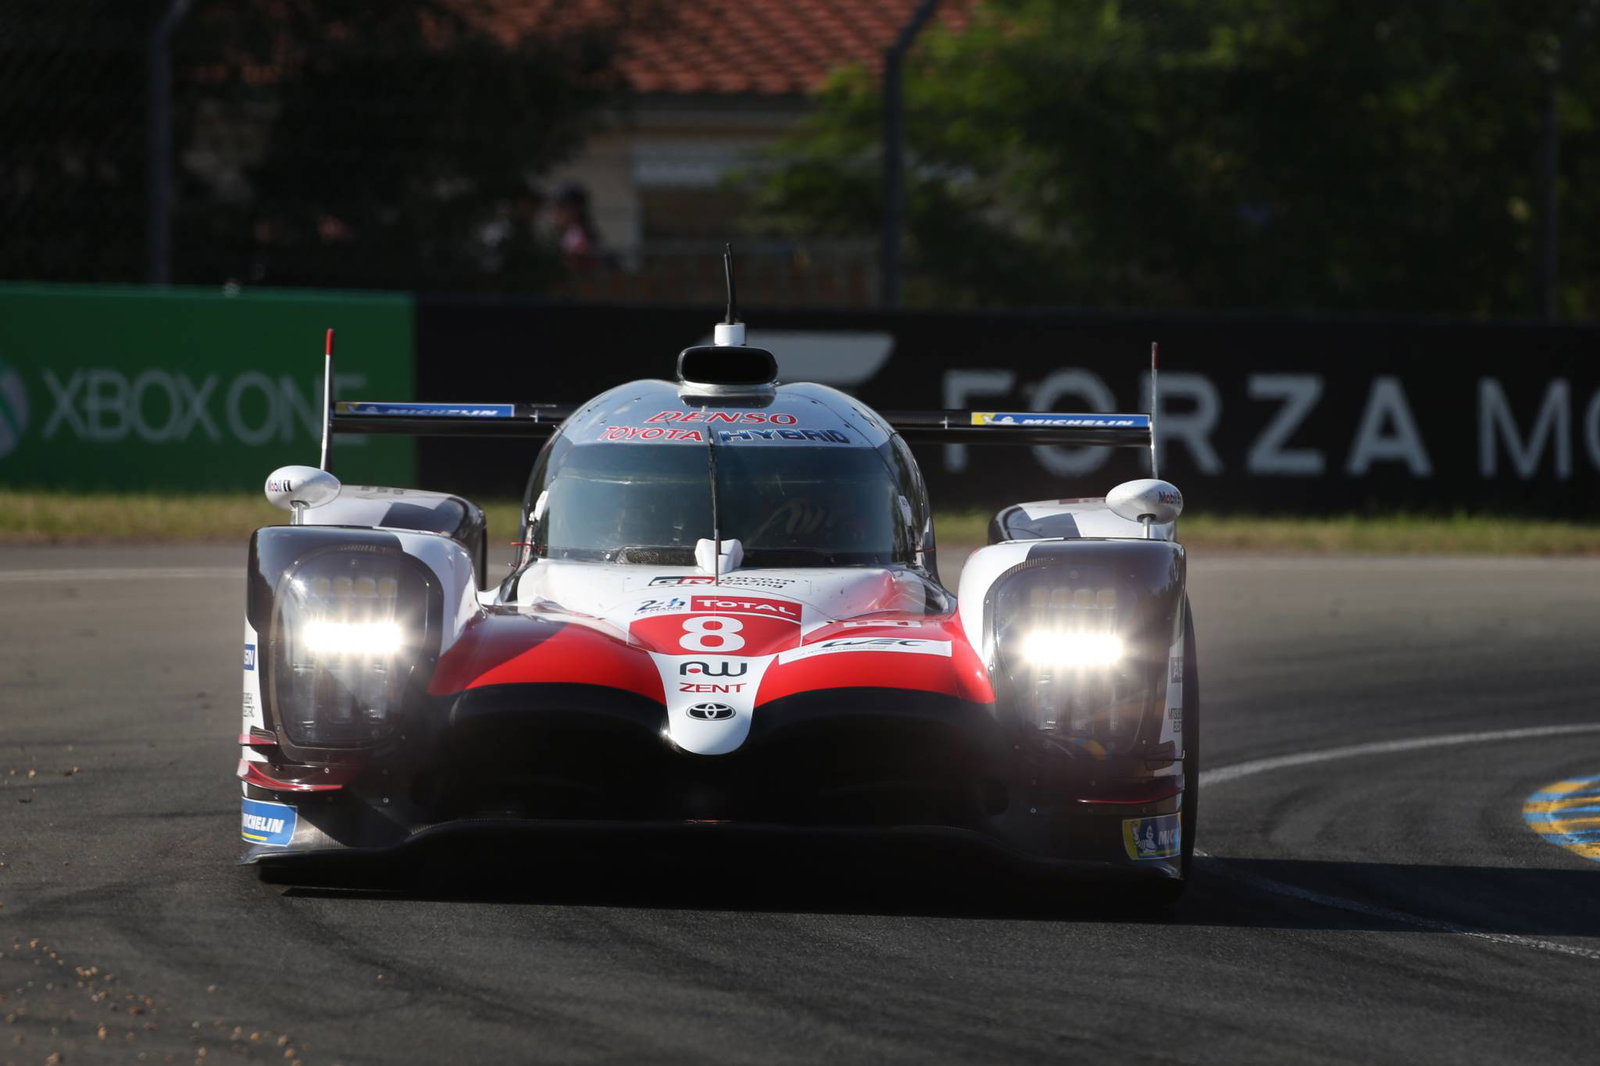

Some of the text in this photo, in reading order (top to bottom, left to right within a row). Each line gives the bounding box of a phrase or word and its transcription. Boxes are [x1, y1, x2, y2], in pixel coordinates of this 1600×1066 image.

[42, 369, 368, 446] XBOX ONE
[643, 410, 799, 426] DENSO
[942, 369, 1600, 481] FORZA M
[1022, 418, 1135, 427] MICHELIN
[597, 425, 851, 444] TOYOTA HYBRID
[696, 599, 797, 616] TOTAL
[679, 615, 746, 652] 8
[821, 638, 929, 648] WEC
[679, 682, 748, 693] ZENT
